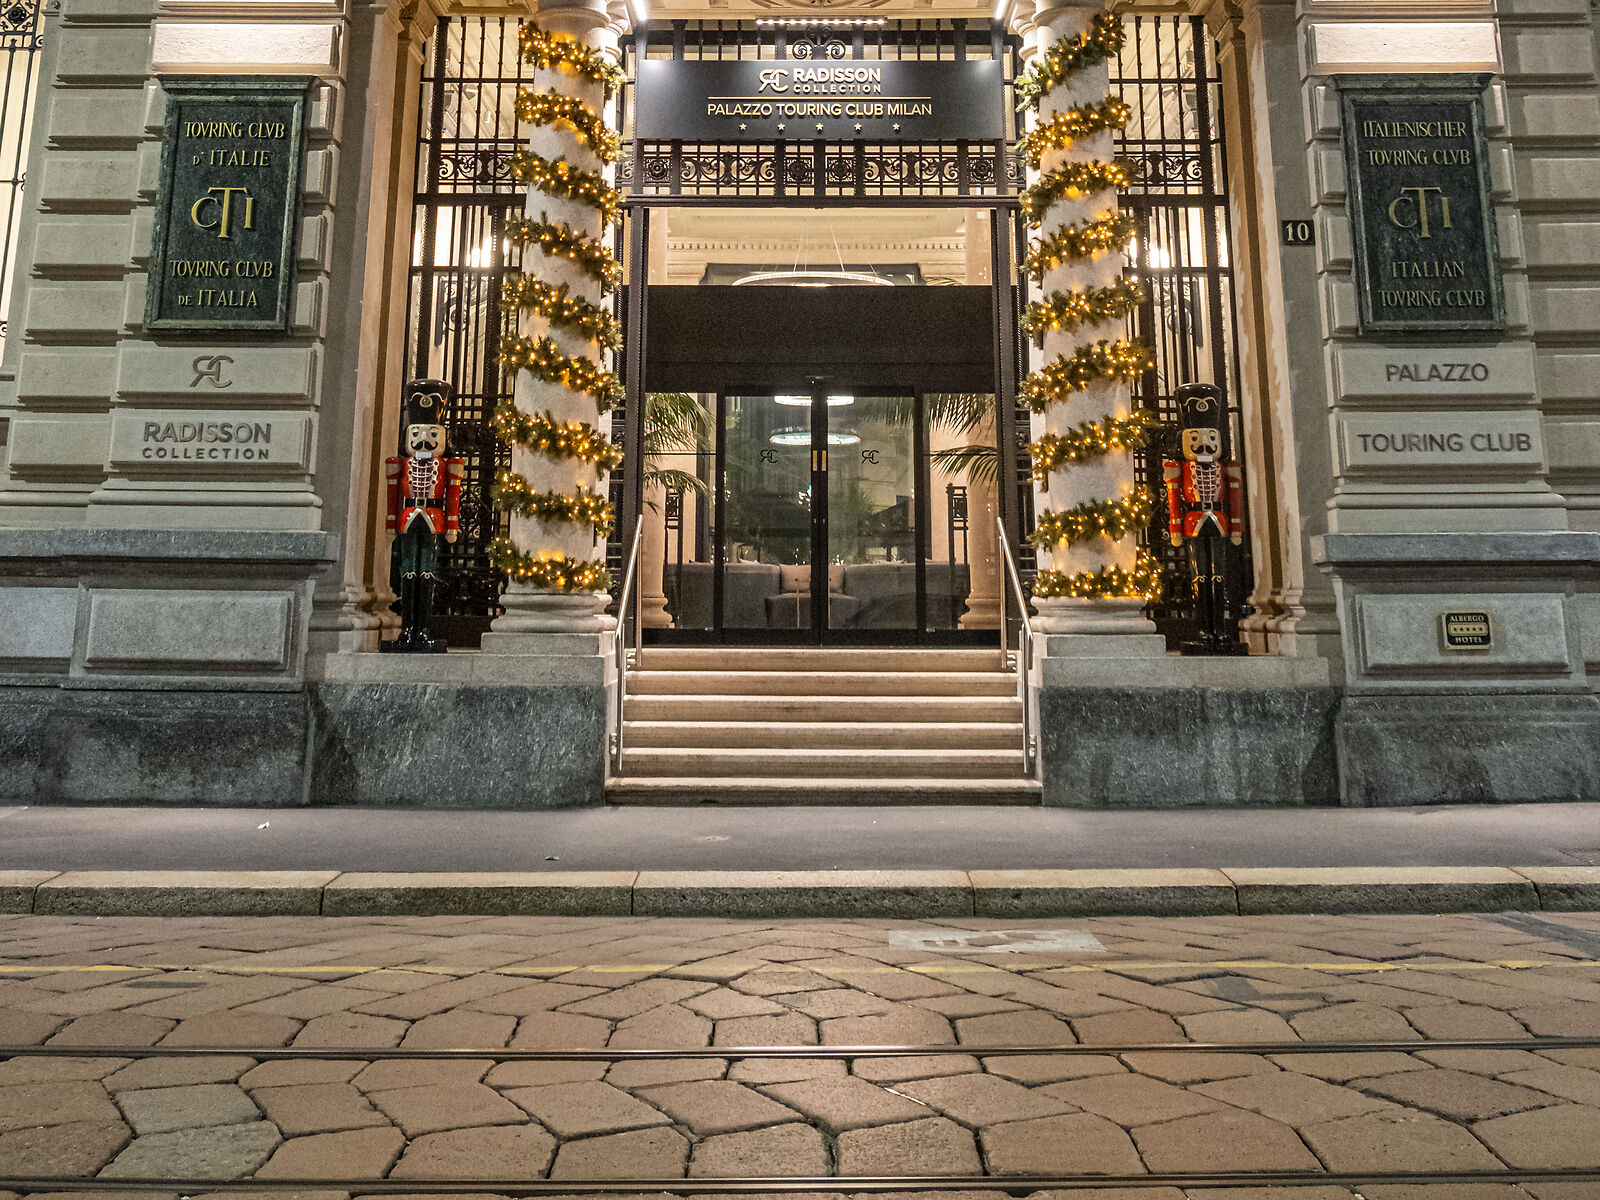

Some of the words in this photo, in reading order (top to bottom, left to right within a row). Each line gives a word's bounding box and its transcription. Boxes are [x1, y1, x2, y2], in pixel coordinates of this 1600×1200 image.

[792, 67, 882, 83] RADISSON
[792, 83, 882, 94] COLLECTION
[707, 103, 773, 117] PALAZZO
[775, 103, 842, 117] TOURING
[845, 103, 884, 117] CLUB
[887, 103, 932, 117] MILAN
[185, 121, 242, 138] TOVRING
[248, 122, 285, 139] CLVB
[1363, 120, 1467, 138] ITALIENISCHER
[1366, 149, 1428, 166] TOVRING
[1433, 149, 1470, 166] CLVB
[191, 187, 254, 238] CTI
[1388, 186, 1452, 238] CTI
[1286, 222, 1309, 241] 10
[170, 260, 230, 278] TOVRING
[235, 260, 273, 278] CLVB
[1392, 261, 1465, 278] ITALIAN
[198, 289, 257, 307] ITALIA
[1378, 290, 1441, 307] TOVRING
[1446, 289, 1486, 307] CLVB
[1385, 363, 1489, 382] PALAZZO
[143, 421, 273, 444] RADISSON
[1357, 433, 1464, 452] TOURING
[1470, 432, 1532, 452] CLUB
[142, 447, 270, 460] COLLECTION
